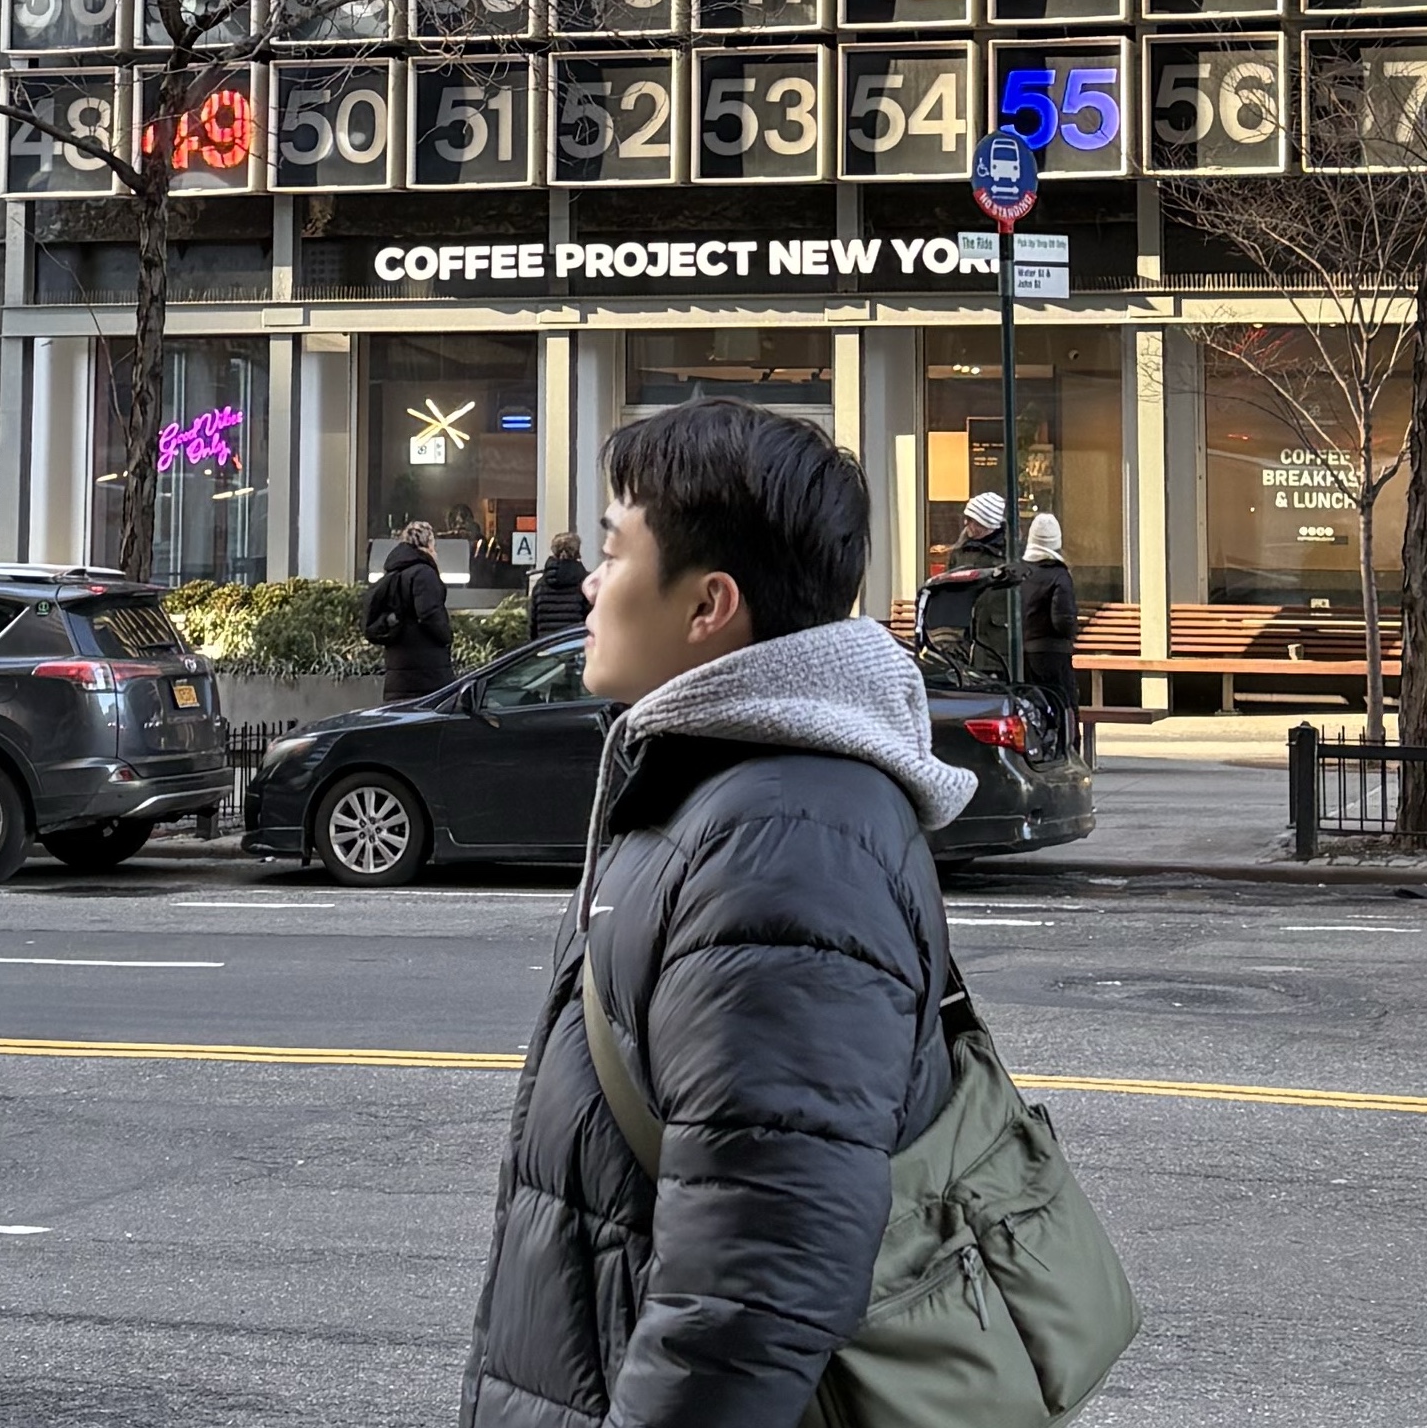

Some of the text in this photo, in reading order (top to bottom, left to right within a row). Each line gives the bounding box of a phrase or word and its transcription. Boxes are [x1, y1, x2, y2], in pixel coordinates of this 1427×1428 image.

[11, 97, 113, 172] 48
[279, 89, 387, 165] 50
[435, 84, 512, 161] 51
[561, 81, 670, 158] 52
[703, 77, 817, 154] 53
[850, 73, 966, 153] 54
[1000, 68, 1119, 150] 55
[1156, 64, 1275, 144] 56
[979, 192, 1033, 220] NO STANDING
[962, 237, 993, 250] The Ride
[374, 245, 545, 281] COFFEE
[556, 241, 757, 278] PROJECT
[769, 238, 883, 275] NEW
[158, 418, 200, 472] Good
[186, 433, 231, 466] Only
[1280, 449, 1351, 465] COFFEE
[1275, 492, 1357, 509] & LUNCH
[517, 536, 532, 556] A
